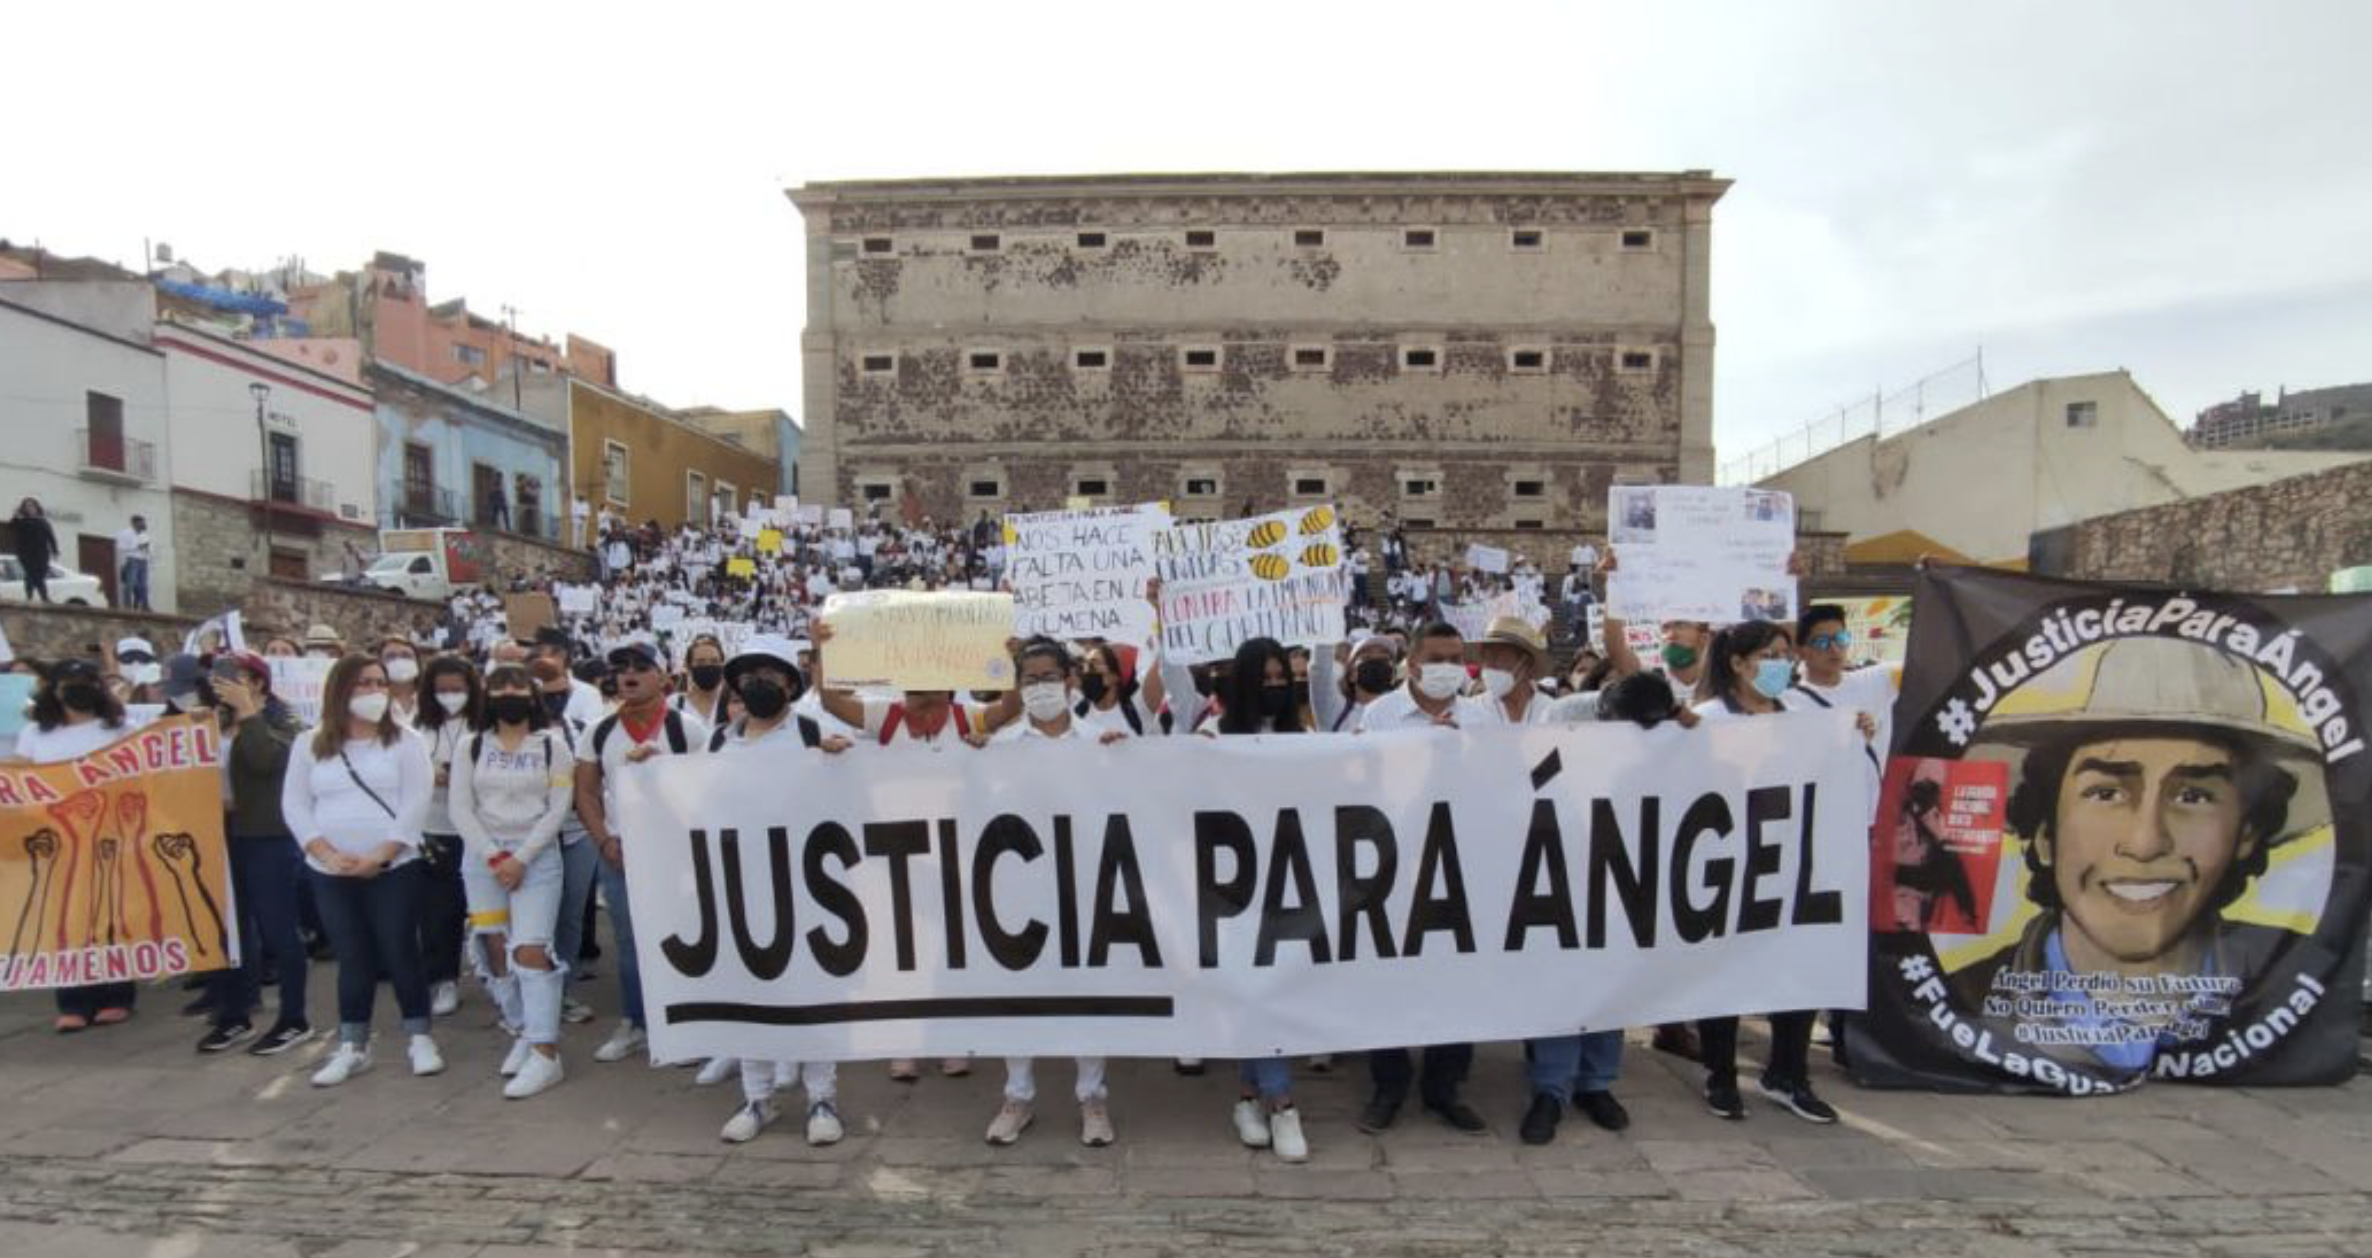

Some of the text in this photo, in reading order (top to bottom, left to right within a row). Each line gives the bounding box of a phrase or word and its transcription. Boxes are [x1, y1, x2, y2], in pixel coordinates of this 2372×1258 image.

[1016, 525, 1131, 552] NOS HACE
[1013, 548, 1146, 579] FALTA UNA
[1094, 580, 1123, 602] EN
[1935, 598, 2364, 765] #JusticiaParaÁngel
[660, 746, 1843, 981] JUSTICIA PARA ÁNGEL
[0, 942, 187, 988] JAMENOS
[2124, 975, 2156, 994] su
[2016, 998, 2088, 1018] Quiero
